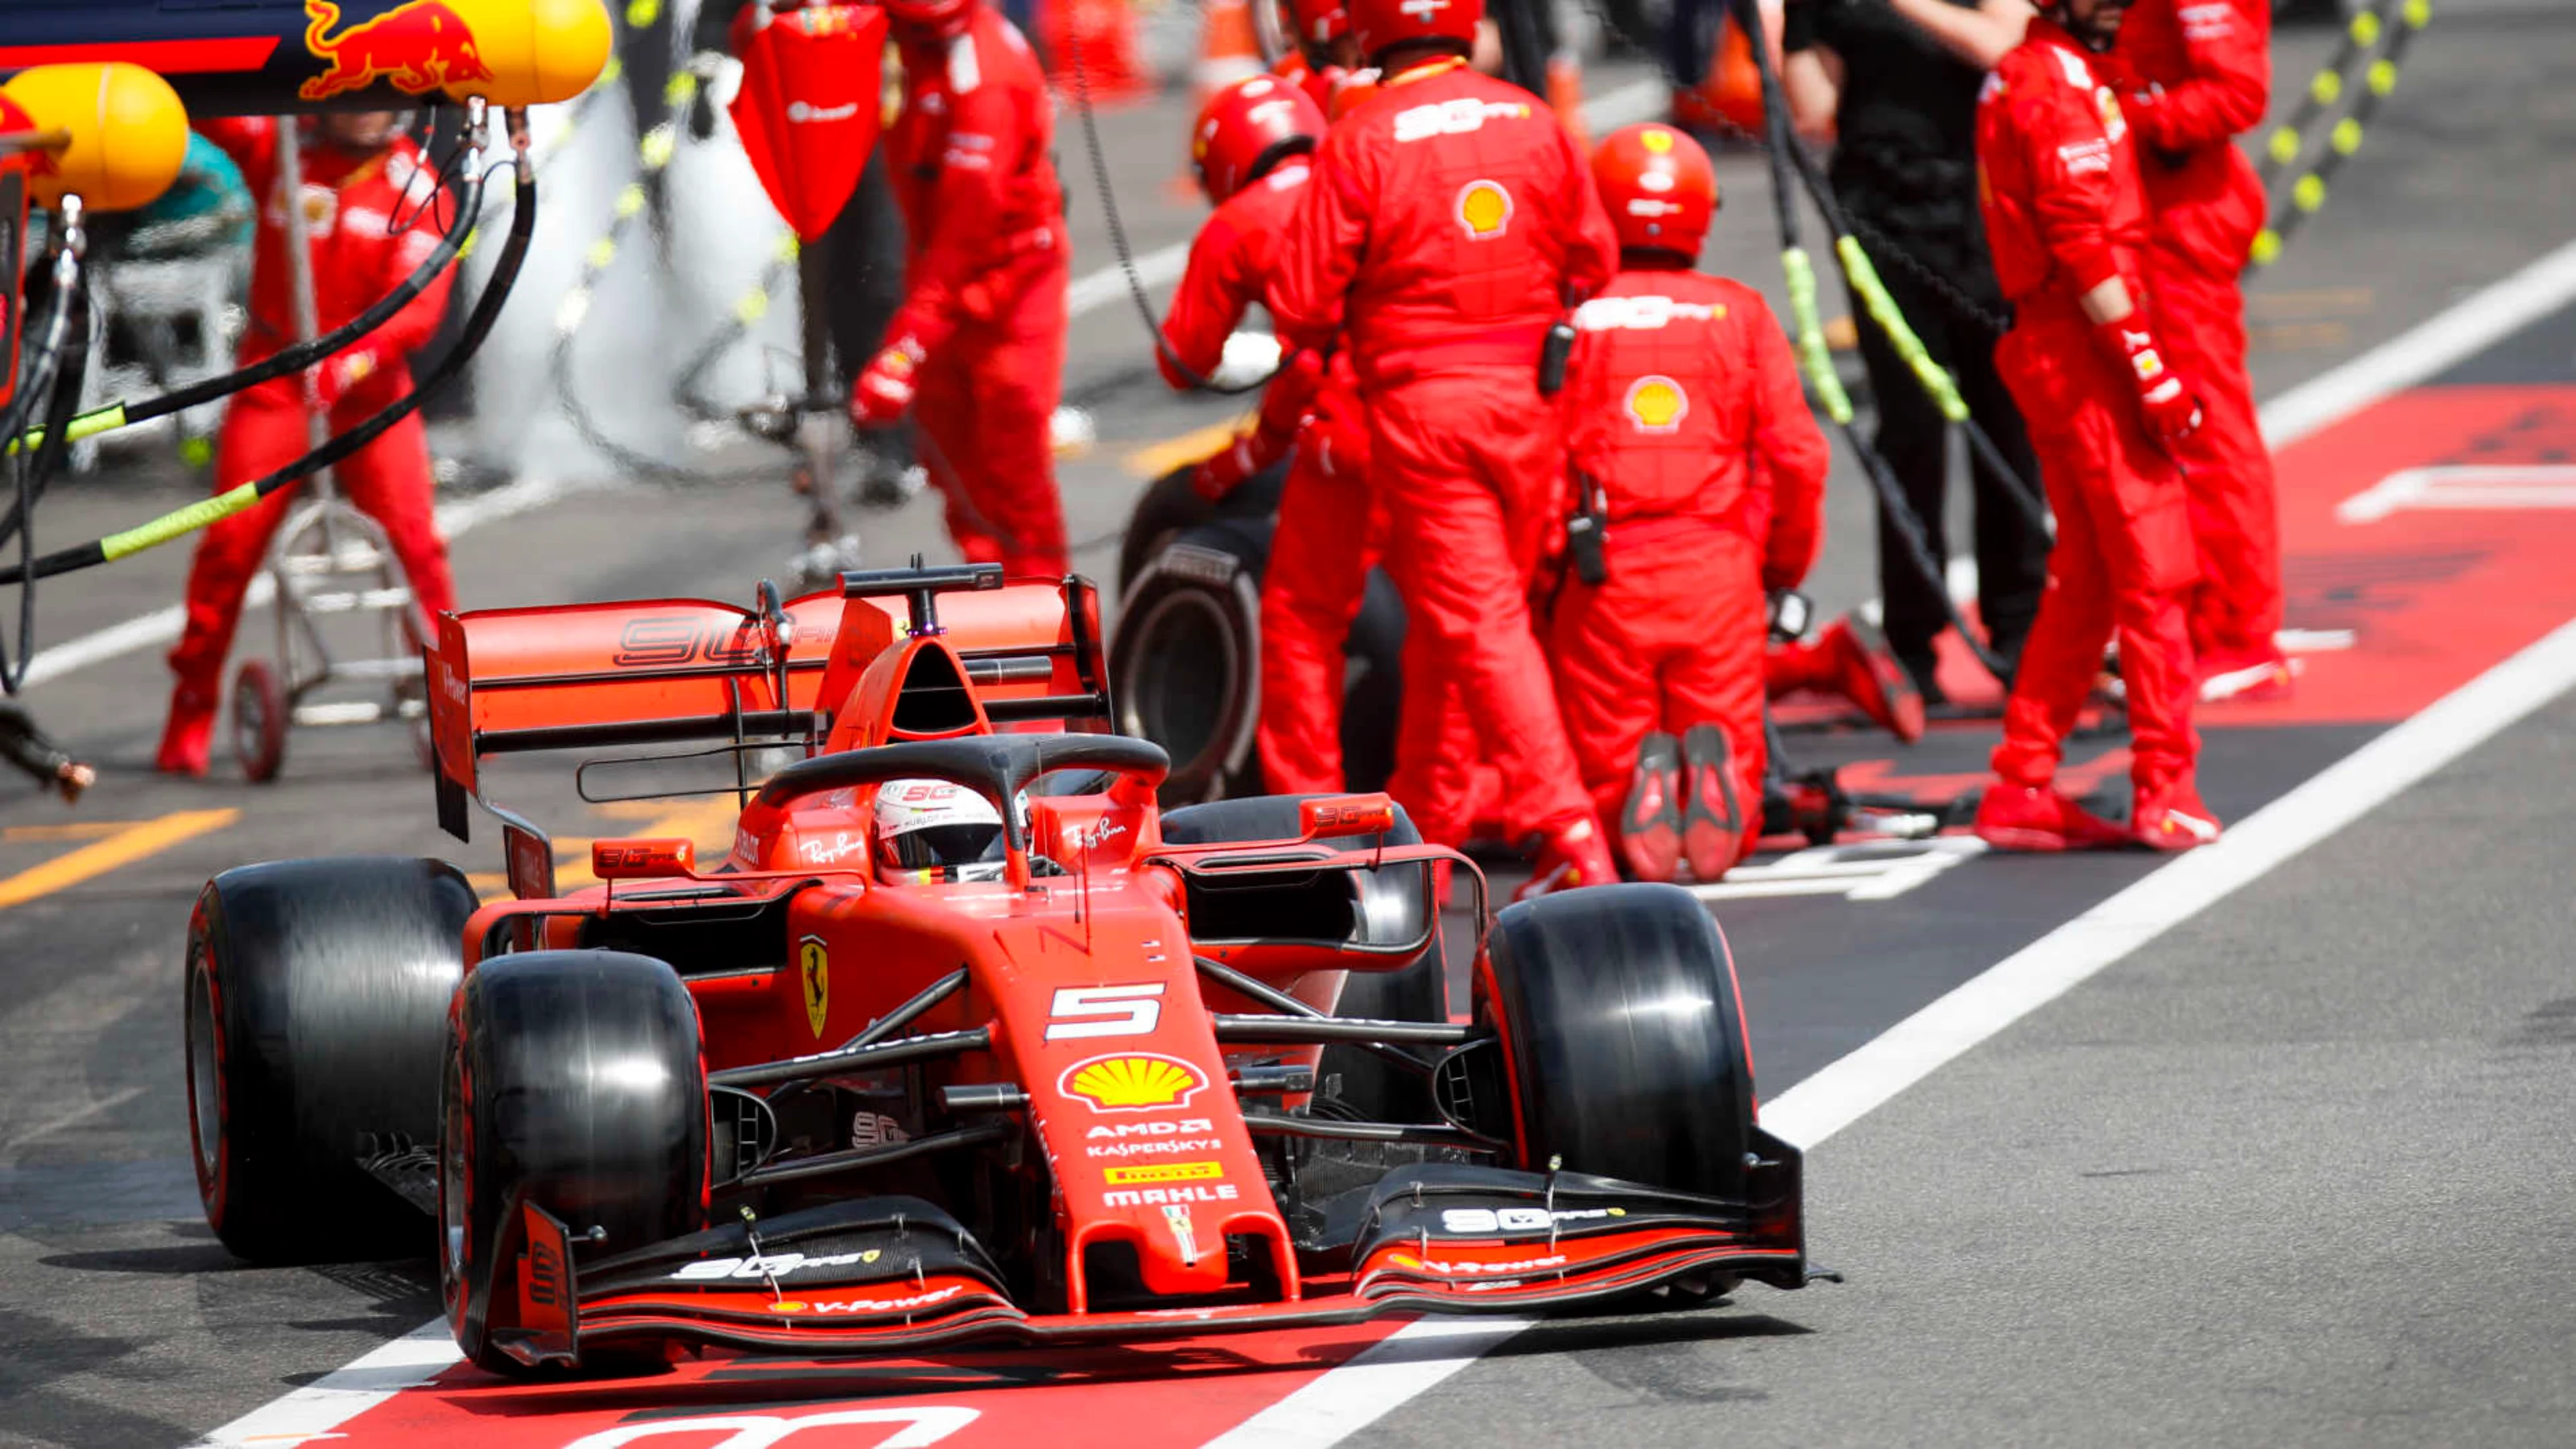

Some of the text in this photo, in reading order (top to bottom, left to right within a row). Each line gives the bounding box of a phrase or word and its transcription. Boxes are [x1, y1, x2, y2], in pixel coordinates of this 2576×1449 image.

[1044, 982, 1167, 1040] 5
[1086, 1121, 1178, 1139] AMD
[1087, 1140, 1208, 1157] KASPERSKY
[1102, 1185, 1239, 1208] MAHLE
[1423, 1255, 1566, 1273] V-Power
[813, 1285, 963, 1315] V-Power
